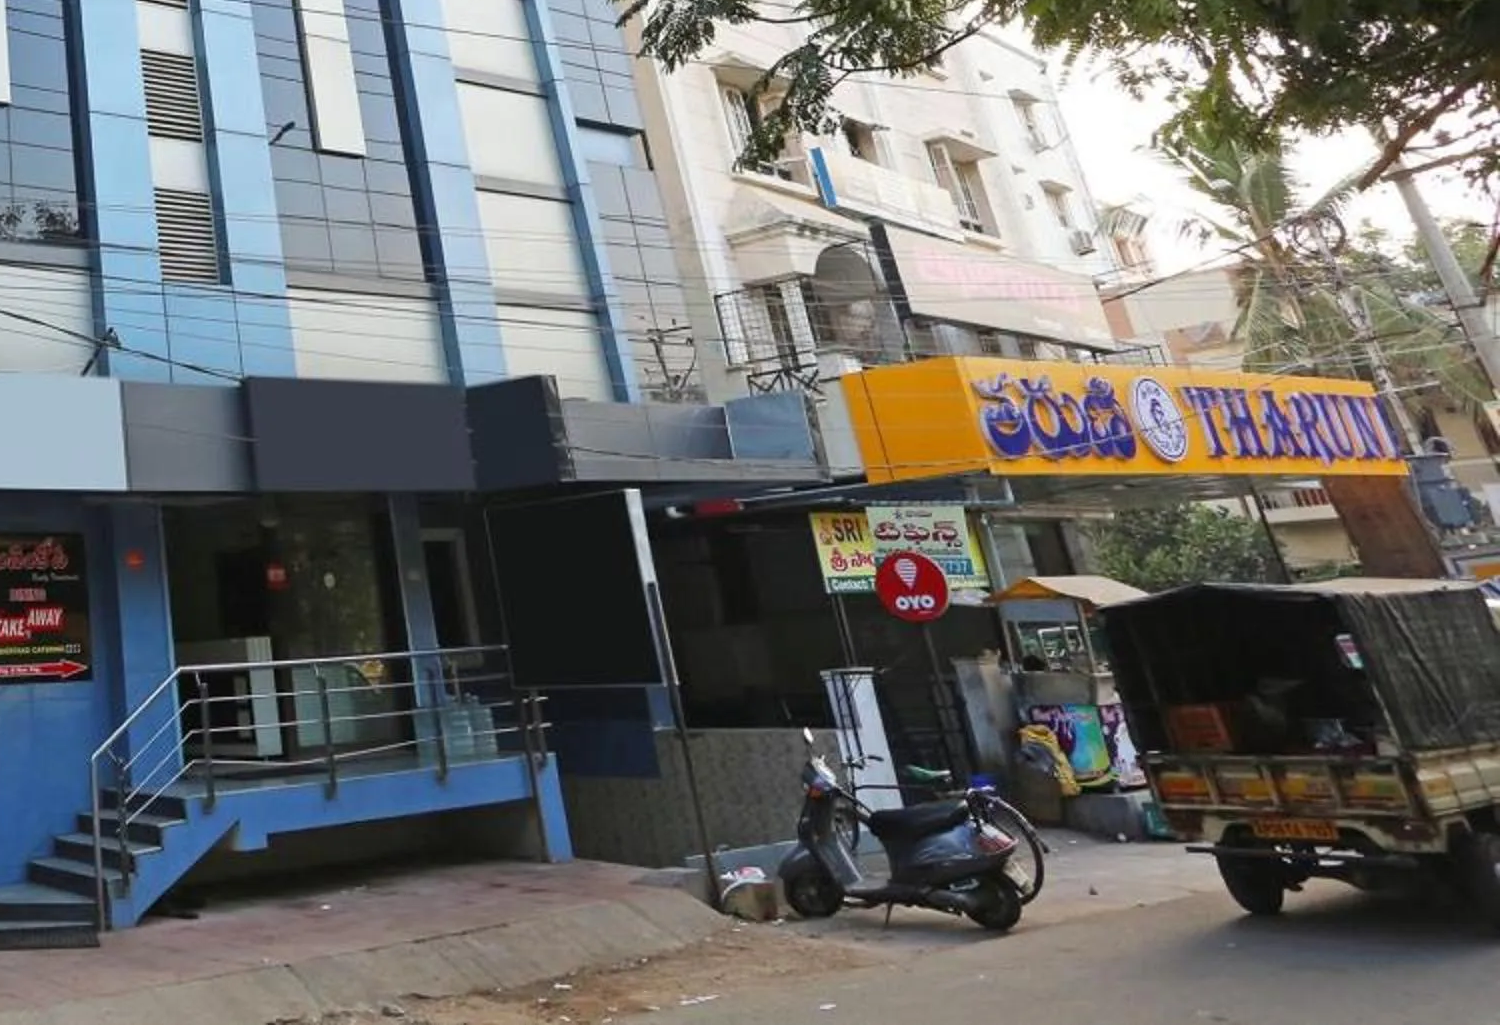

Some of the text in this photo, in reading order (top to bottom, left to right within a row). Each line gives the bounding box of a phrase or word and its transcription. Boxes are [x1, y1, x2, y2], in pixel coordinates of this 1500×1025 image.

[1181, 386, 1405, 466] THARUNI
[832, 518, 864, 543] SRI
[895, 595, 935, 610] OYO
[27, 607, 64, 626] AWAY
